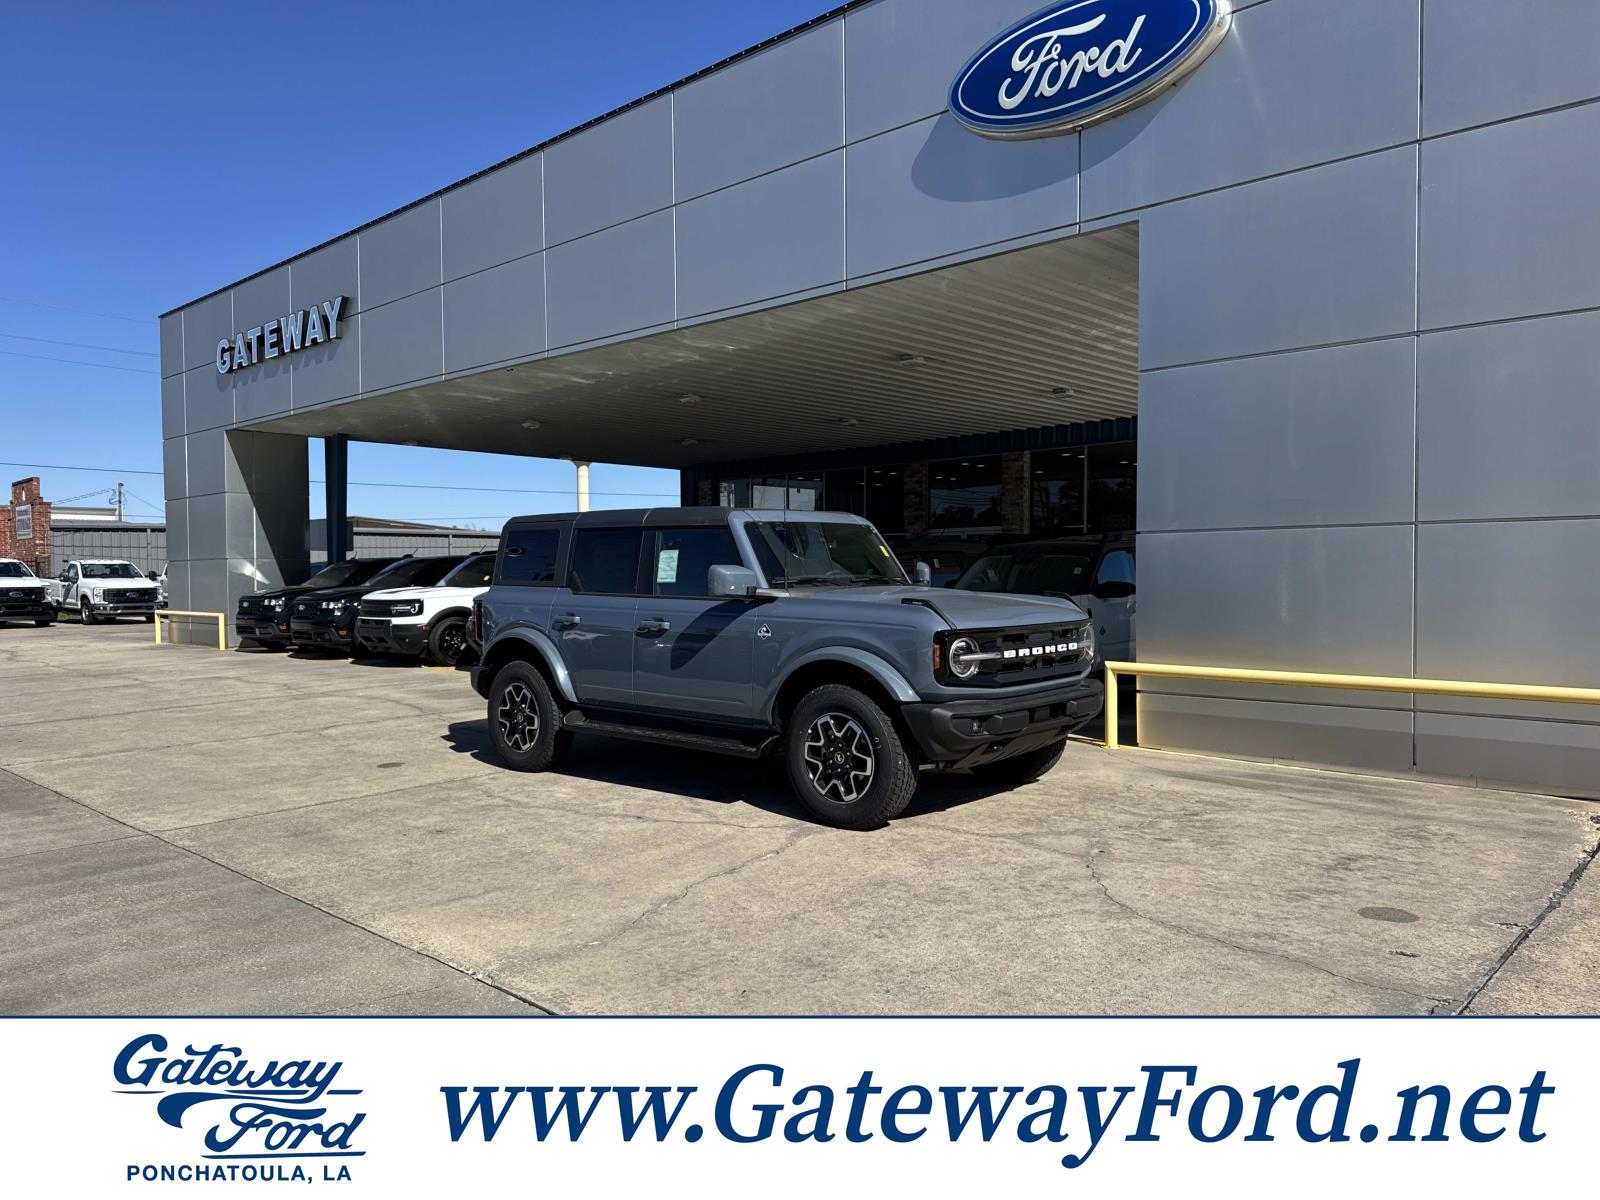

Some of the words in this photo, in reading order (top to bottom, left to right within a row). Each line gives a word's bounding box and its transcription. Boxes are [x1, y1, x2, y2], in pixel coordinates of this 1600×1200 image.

[998, 14, 1146, 110] Ford
[216, 296, 344, 374] GATEWAY
[1003, 642, 1078, 658] BRONCO
